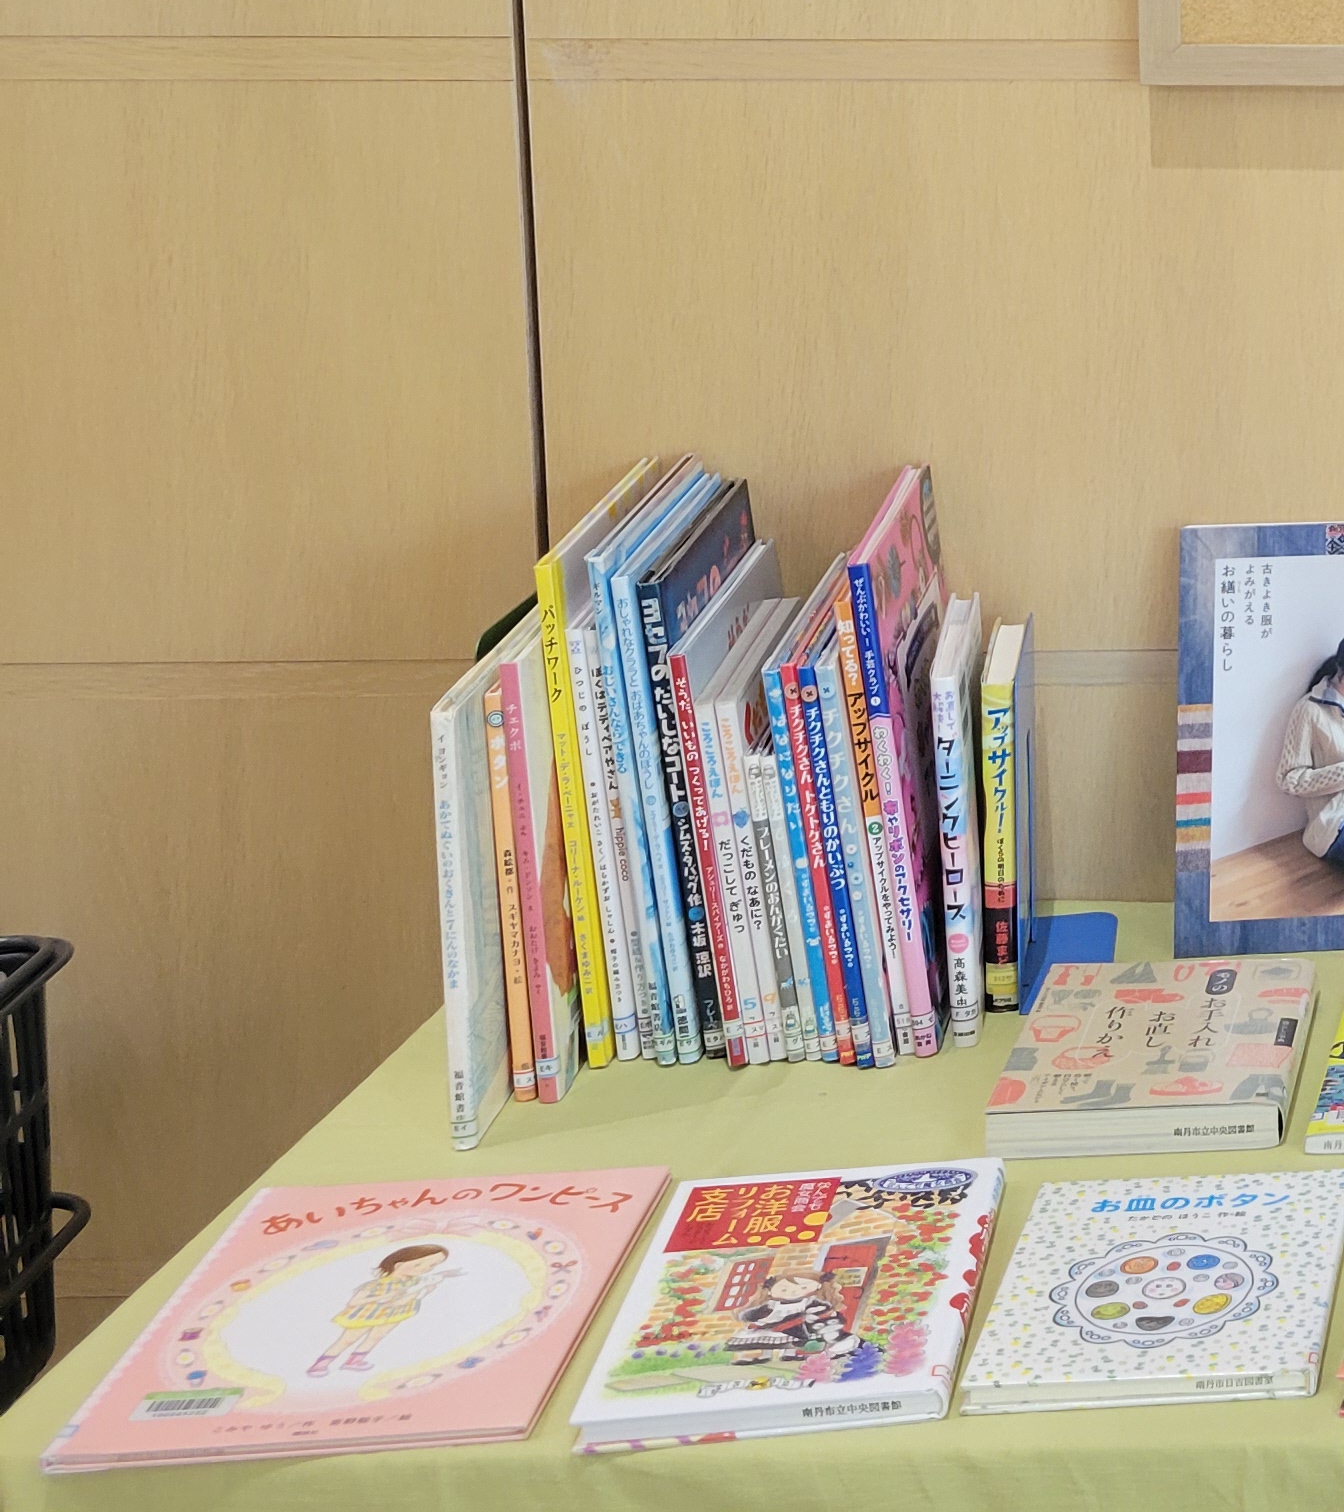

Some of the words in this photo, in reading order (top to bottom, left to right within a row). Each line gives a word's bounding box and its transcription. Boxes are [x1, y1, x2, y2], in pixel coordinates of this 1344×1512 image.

[1219, 564, 1236, 672] お繕いの暮らし
[1243, 563, 1256, 626] よみがえる
[1260, 563, 1274, 639] 古きよき服が
[541, 605, 563, 704] パッチワーク
[837, 620, 858, 686] 知ってる？
[864, 650, 879, 696] 手芸クラブ
[505, 703, 523, 752] チェクポ
[573, 666, 588, 713] ひつじの
[581, 721, 593, 756] ぼうし
[490, 735, 508, 789] ボタン
[701, 721, 723, 800] ころころえほん
[721, 717, 743, 795] ころころえほん
[823, 709, 857, 834] チクチクさん
[847, 691, 880, 803] アップサイクル
[872, 725, 893, 797] わくわく！
[788, 704, 814, 786] チクチクさん
[804, 790, 827, 869] トゲトゲさん
[805, 706, 847, 890] チクチクさんともりのかいぶつ
[618, 859, 630, 882] coco
[719, 839, 738, 896] だっこして
[740, 835, 757, 881] くだもの
[1092, 1006, 1135, 1059] 作りかえ
[1145, 1010, 1178, 1049] お直し
[1187, 997, 1227, 1048] お手入れ
[1173, 1124, 1256, 1138] 南丹市立中央図書館
[261, 1182, 635, 1236] あいちゃんのワンピース
[686, 1188, 735, 1223] 支店
[712, 1186, 756, 1246] リフォーム
[743, 1184, 794, 1234] お洋服
[1091, 1192, 1291, 1214] お皿のボタン
[802, 1400, 903, 1419] 南丹市立中央図書館
